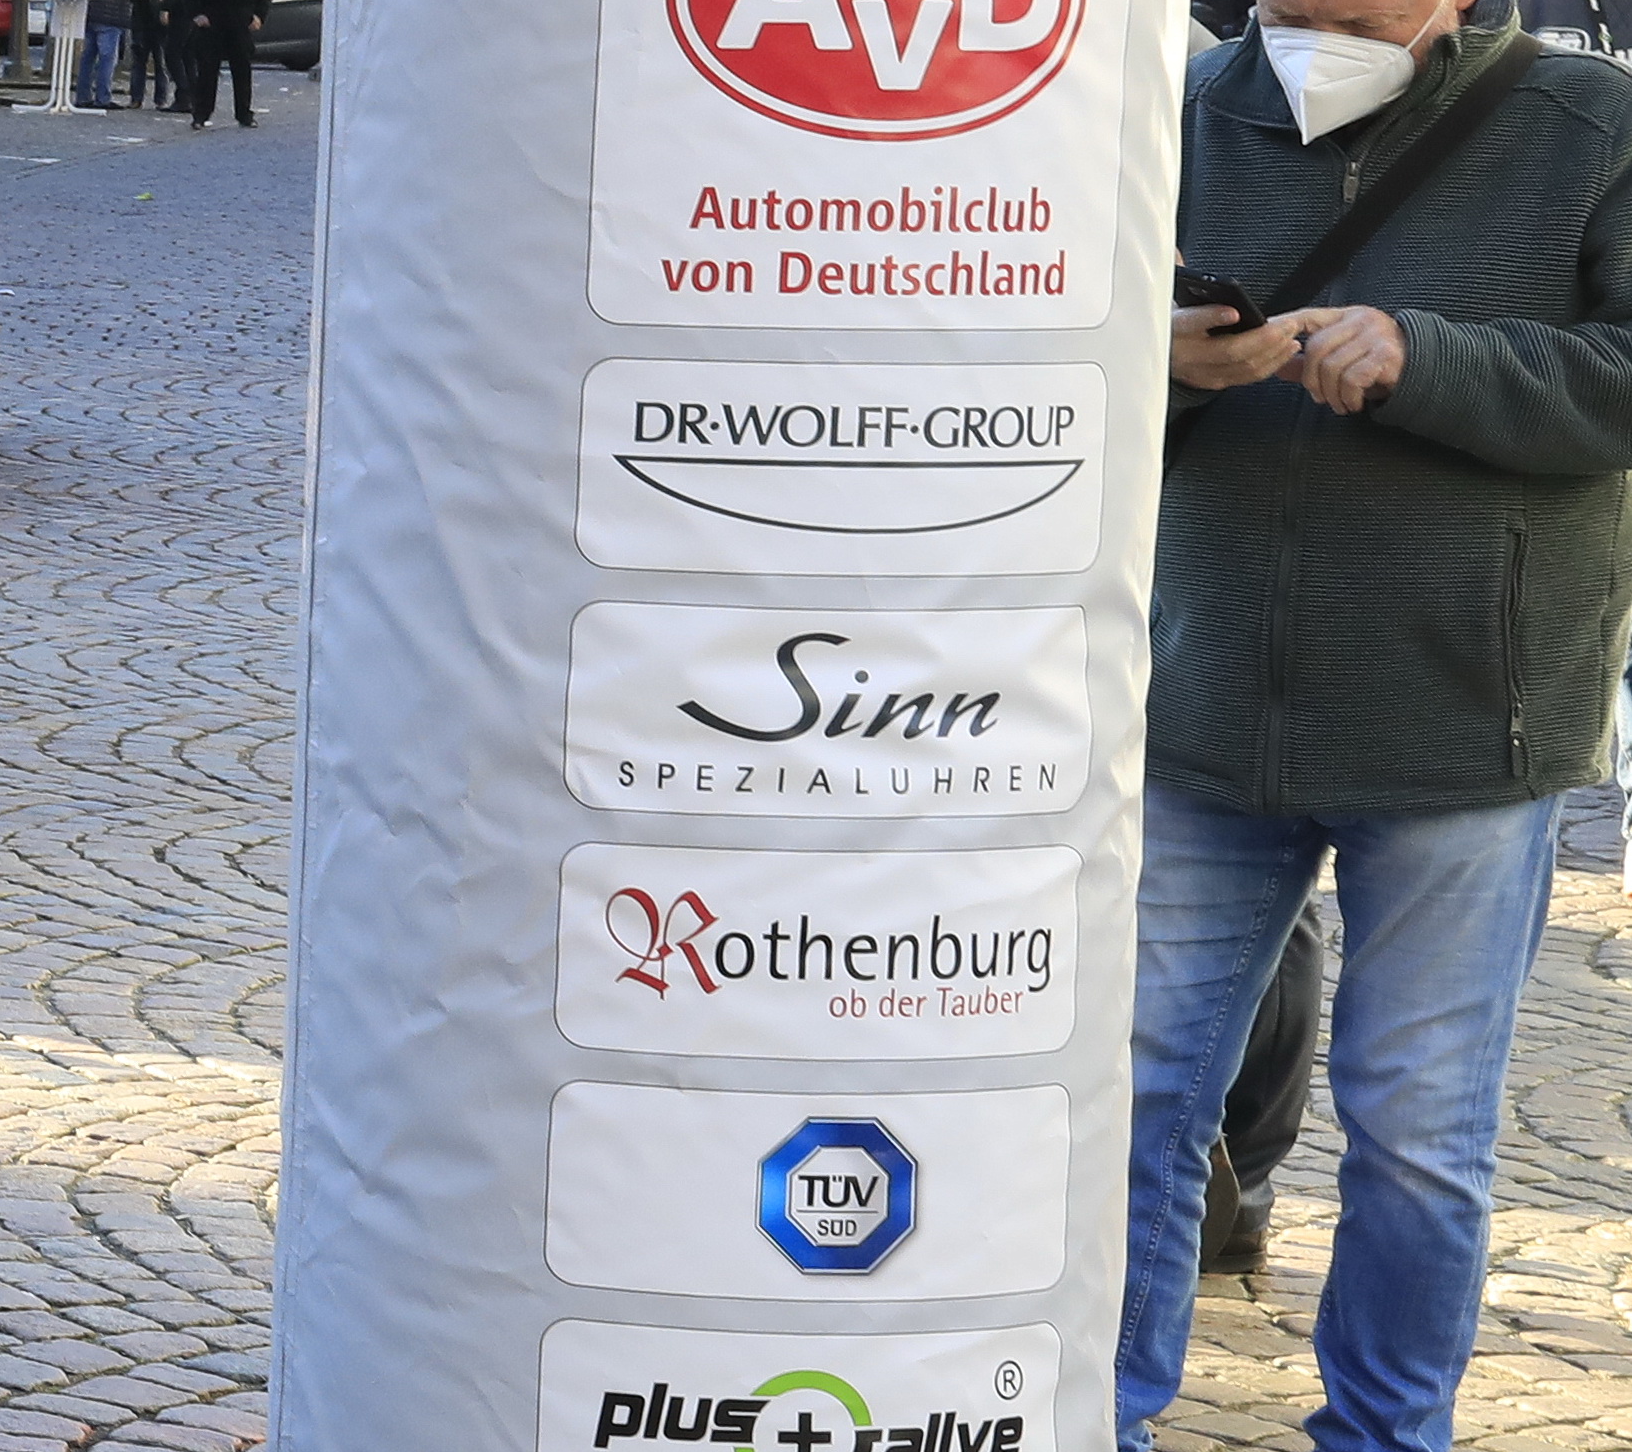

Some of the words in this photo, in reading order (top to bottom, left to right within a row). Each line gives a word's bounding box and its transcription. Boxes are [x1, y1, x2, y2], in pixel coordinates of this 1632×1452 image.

[689, 185, 1051, 234] Automobilclub
[660, 257, 755, 295] von
[778, 250, 1067, 298] Deutschland
[675, 632, 1002, 743] Sinn
[617, 760, 1058, 796] SPEZIALUHREN
[604, 886, 1052, 1001] Rothenburg
[828, 986, 868, 1019] ob
[878, 988, 927, 1019] der
[938, 986, 1024, 1017] Tauber
[798, 1173, 878, 1209] TÜV
[816, 1217, 859, 1239] SÜD
[593, 1382, 770, 1449] plus
